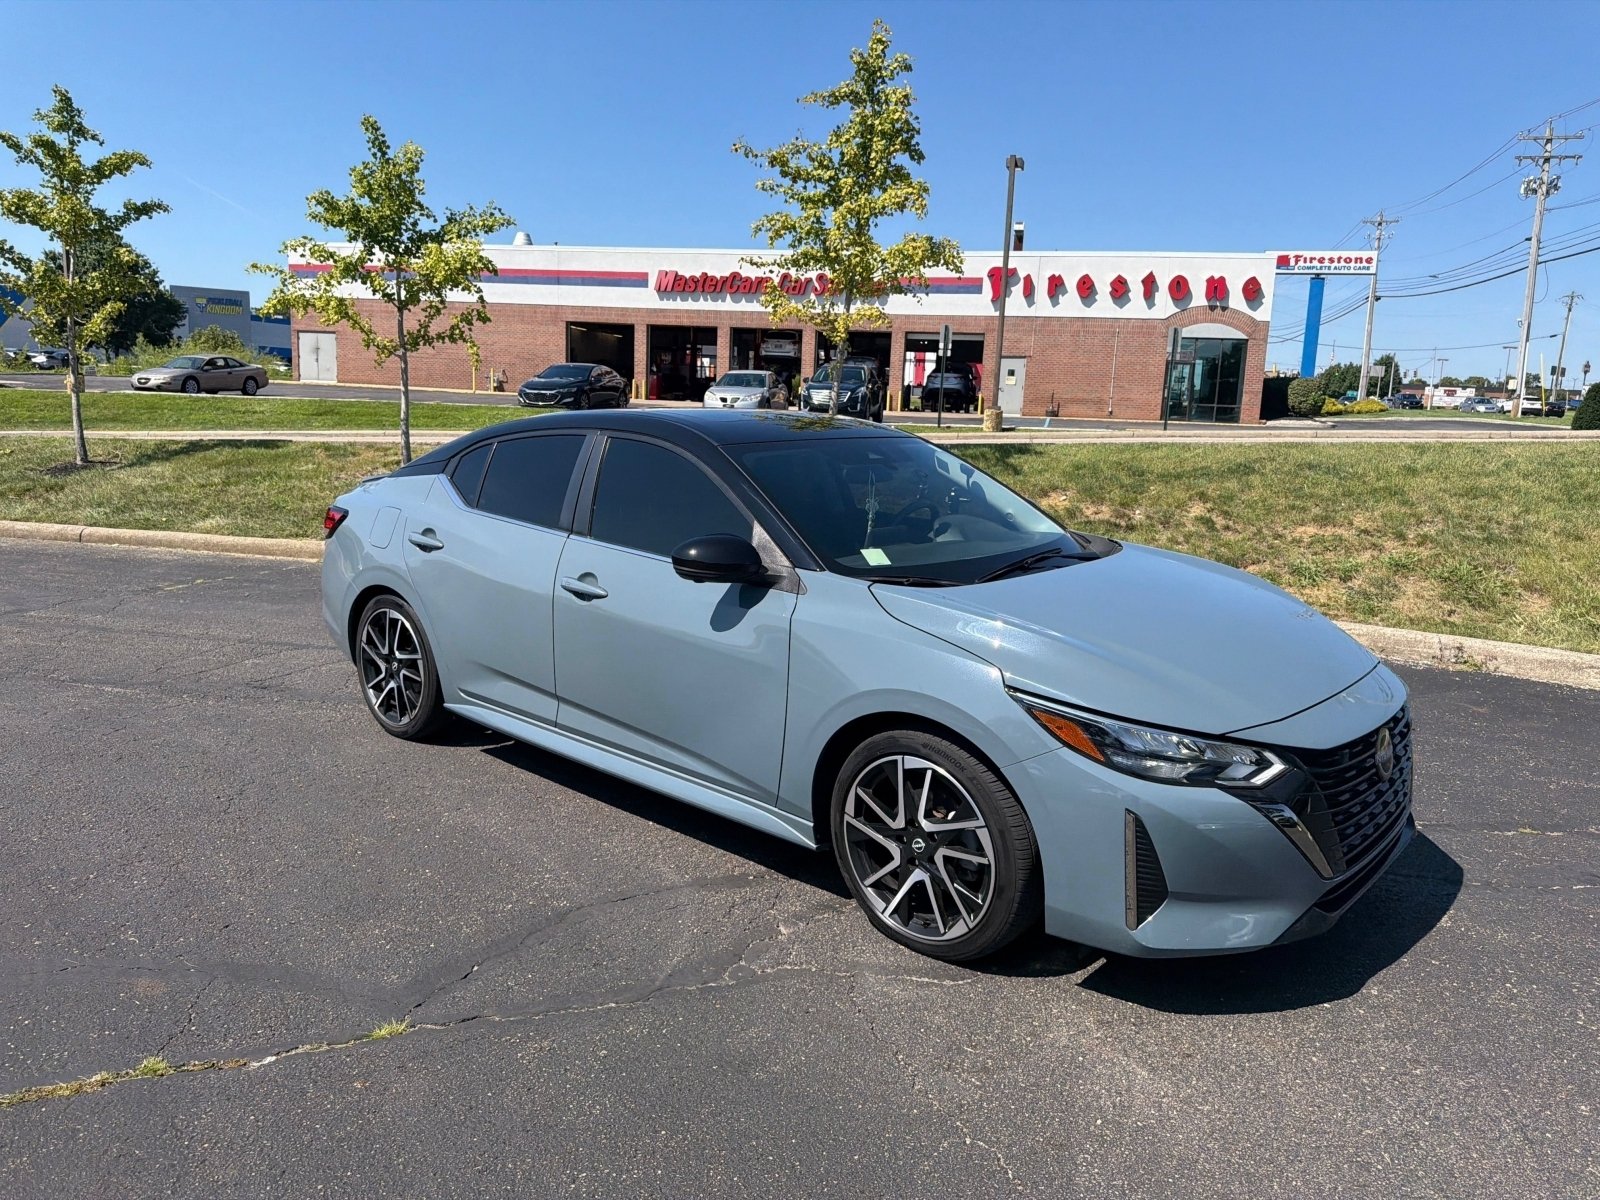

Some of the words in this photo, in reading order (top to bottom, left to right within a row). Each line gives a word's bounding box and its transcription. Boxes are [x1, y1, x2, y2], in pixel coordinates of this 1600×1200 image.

[1293, 254, 1374, 267] Firestone
[654, 269, 774, 294] MasterCare
[987, 266, 1262, 301] Firestone
[206, 304, 243, 315] KINGDOM
